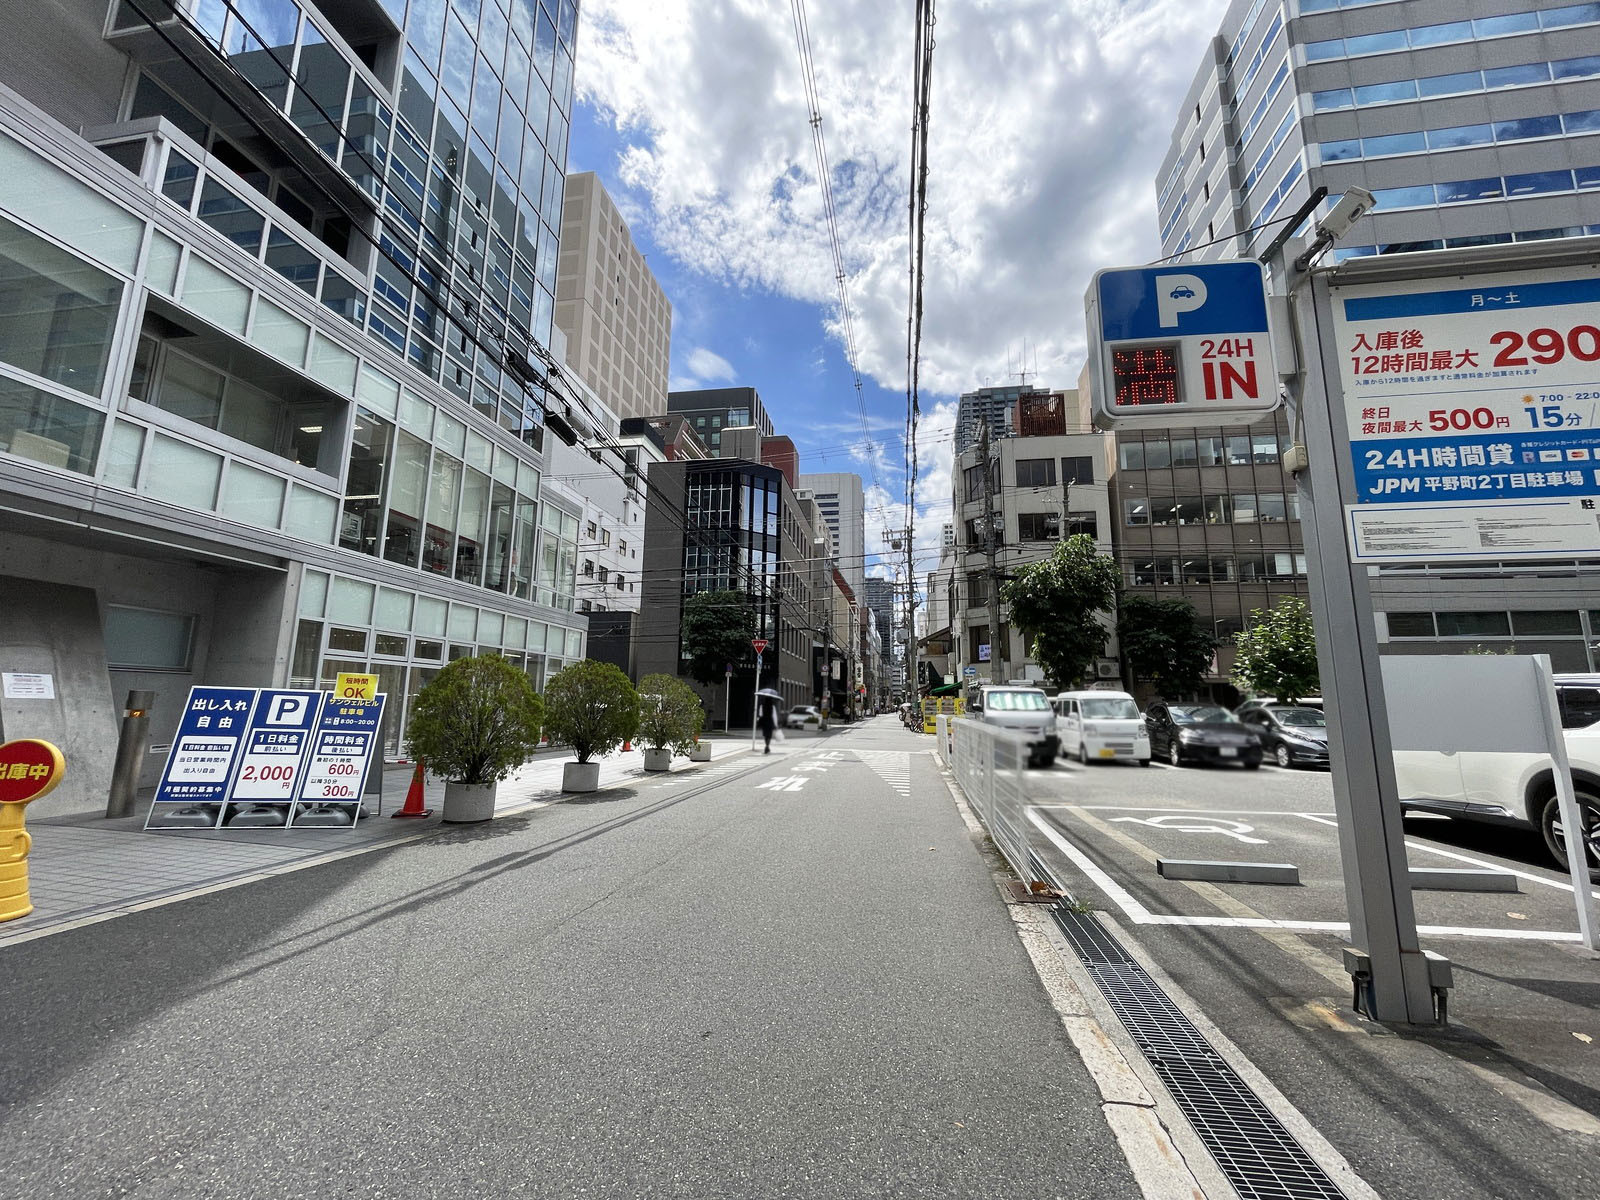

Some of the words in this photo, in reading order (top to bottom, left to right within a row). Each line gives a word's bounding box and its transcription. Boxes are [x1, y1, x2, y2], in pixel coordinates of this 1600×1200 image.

[1156, 274, 1207, 328] P
[1471, 291, 1520, 307] 月～土
[1200, 338, 1254, 359] 24H
[1351, 329, 1424, 353] 入庫後
[1351, 349, 1479, 375] 12時間最大
[1202, 361, 1259, 400] IN
[1539, 394, 1564, 403] 7:00
[1361, 407, 1390, 420] 終日
[1429, 407, 1510, 431] 500円
[1524, 406, 1583, 428] 15分
[1362, 420, 1423, 434] 夜間最大
[1365, 443, 1514, 470] 24H時間貸
[1369, 477, 1420, 495] JPM
[1424, 471, 1584, 491] 平野町2丁目駐車場
[345, 677, 369, 685] 短時間
[343, 687, 366, 699] OK
[191, 698, 248, 711] 出し入れ
[275, 698, 300, 722] P
[259, 734, 299, 744] 1日料金
[324, 735, 365, 745] 時間料金
[242, 765, 294, 783] 2,000
[328, 764, 360, 776] 600円
[322, 785, 355, 797] 300円
